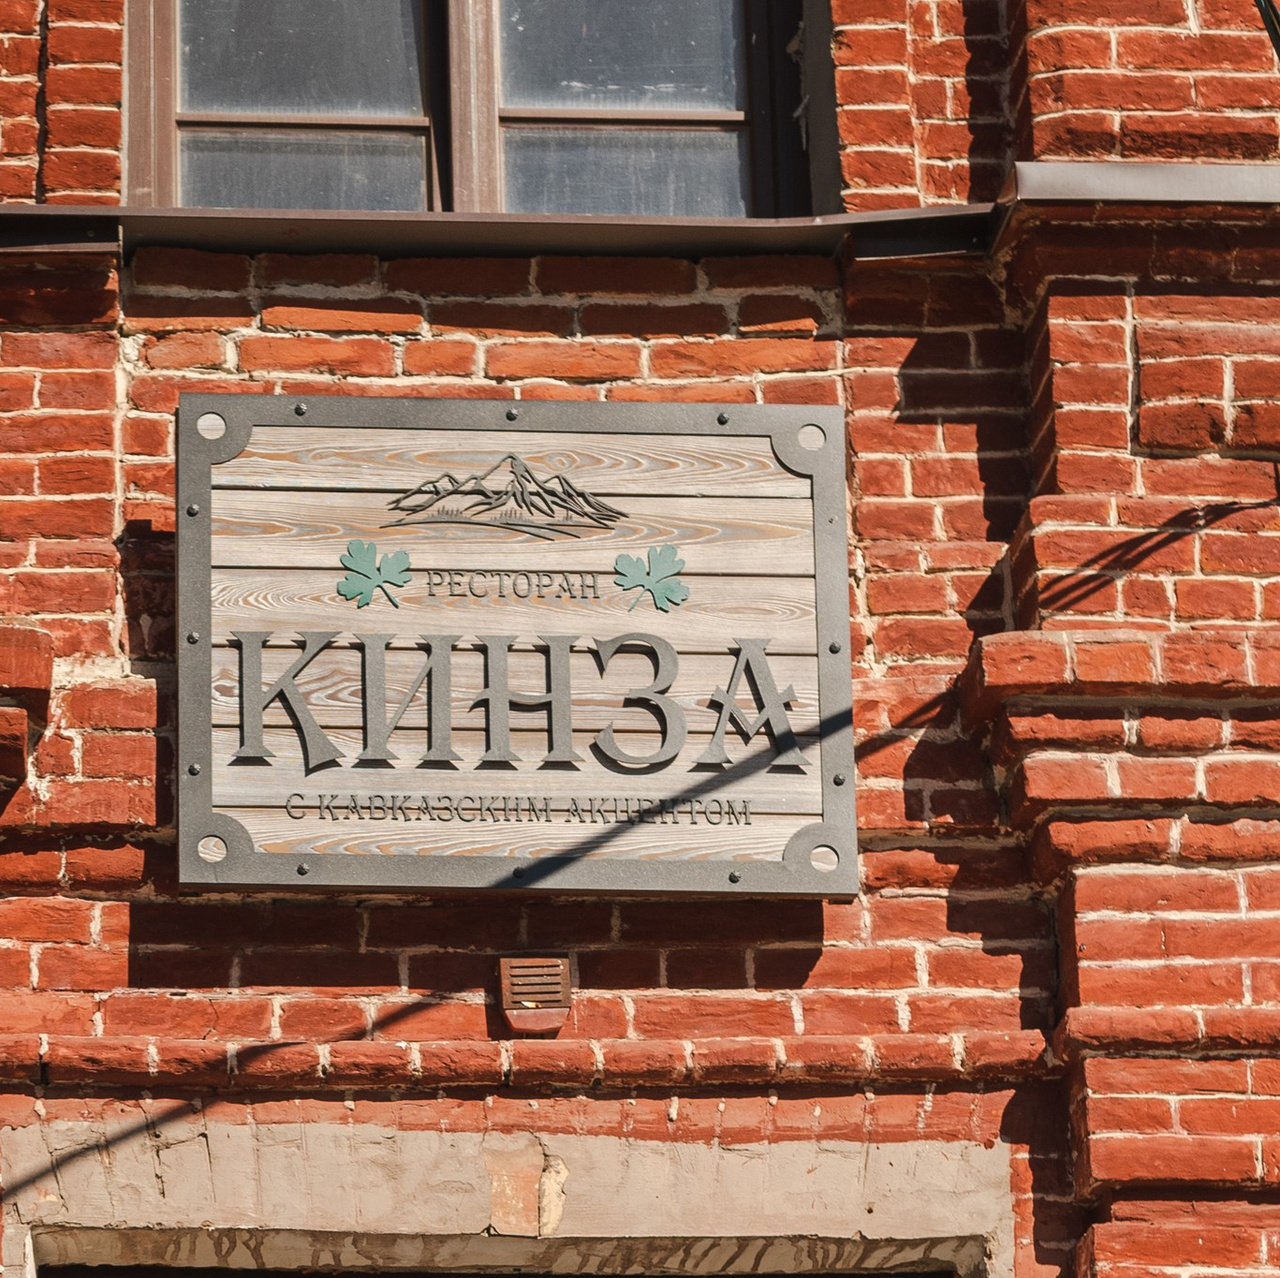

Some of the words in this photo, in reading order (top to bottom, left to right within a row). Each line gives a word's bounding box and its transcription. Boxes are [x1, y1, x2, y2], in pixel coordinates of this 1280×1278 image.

[426, 570, 601, 599] РЕСТОРАН
[228, 631, 811, 770] КИНЗА
[285, 793, 307, 820] С
[318, 794, 553, 823] КАВКАЗСКИМ
[564, 797, 752, 826] АКЦЕНТОМ
